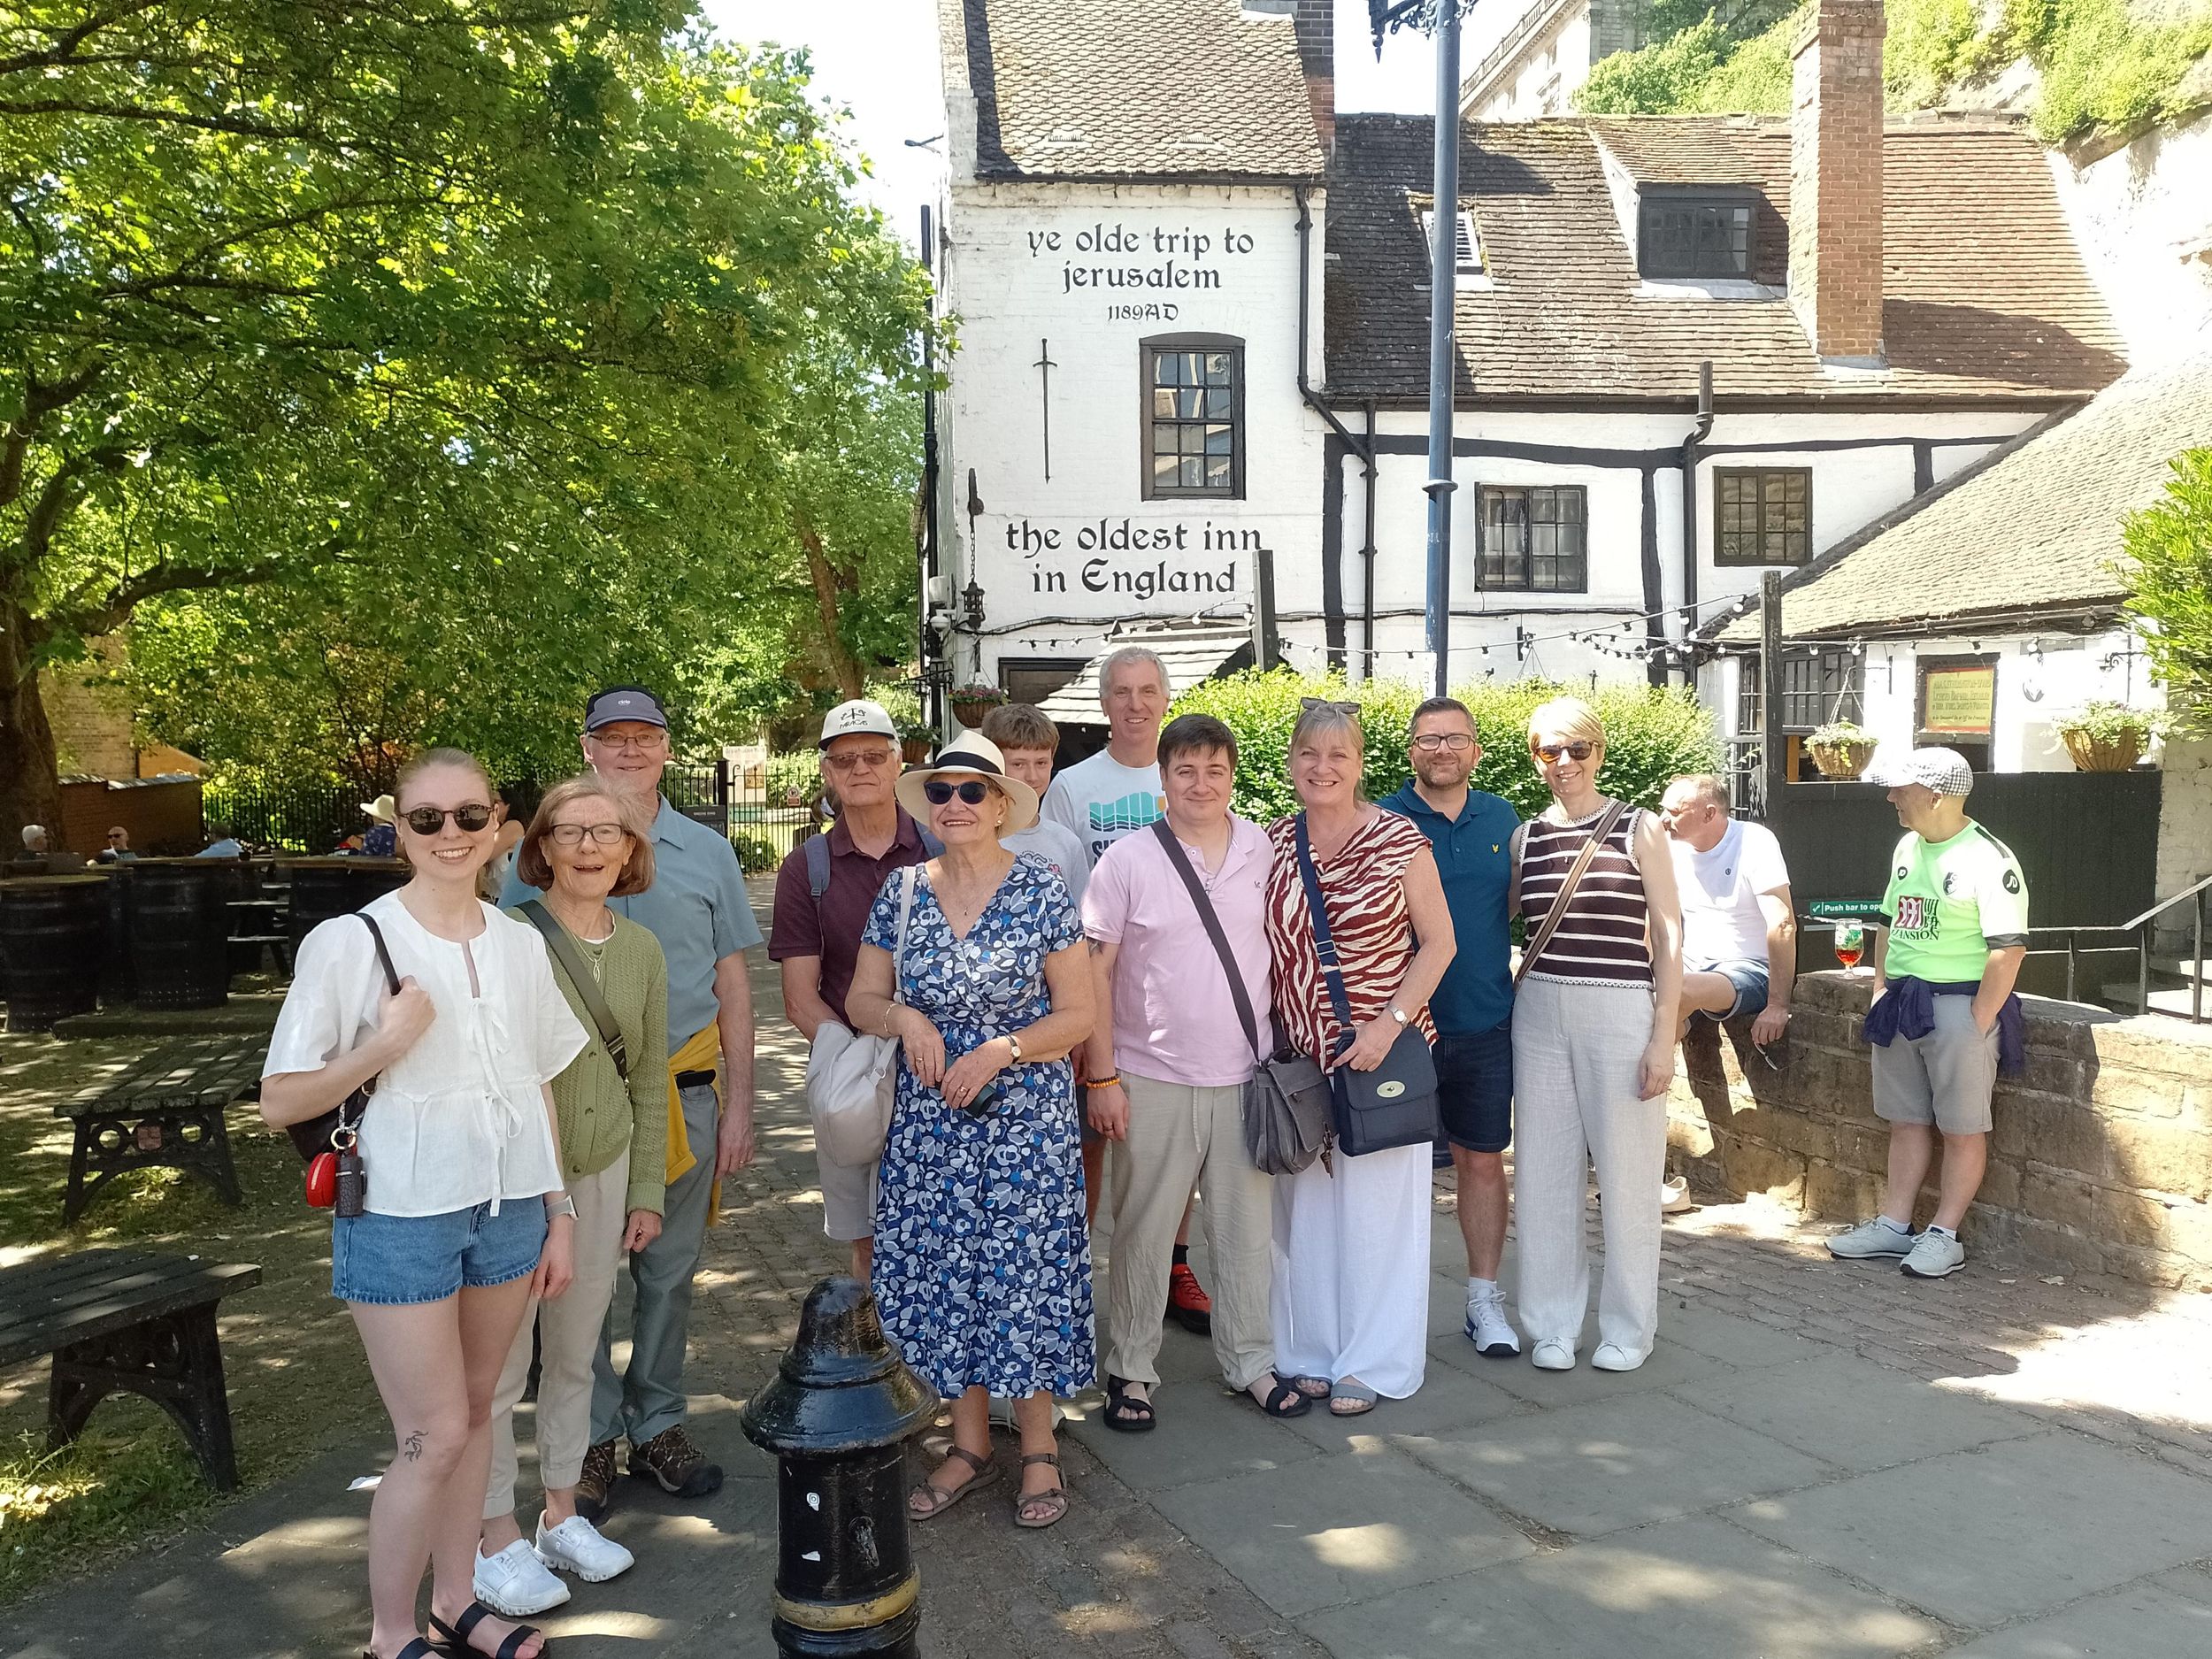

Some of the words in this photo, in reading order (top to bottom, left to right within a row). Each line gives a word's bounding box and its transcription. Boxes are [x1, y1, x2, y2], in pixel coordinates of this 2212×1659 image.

[1027, 227, 1062, 257] ye
[1075, 223, 1140, 253] olde
[1153, 227, 1210, 260] trip
[1224, 227, 1255, 254] to
[1062, 260, 1223, 294] jerusalem
[1107, 303, 1179, 322] 1189AD
[1006, 519, 1062, 558] the
[1077, 518, 1188, 550] oldest
[1204, 521, 1263, 550] inn
[1033, 563, 1067, 593] in
[1081, 557, 1236, 600] England
[1824, 903, 1844, 912] Push
[1845, 902, 1858, 911] bar
[1860, 902, 1868, 911] to
